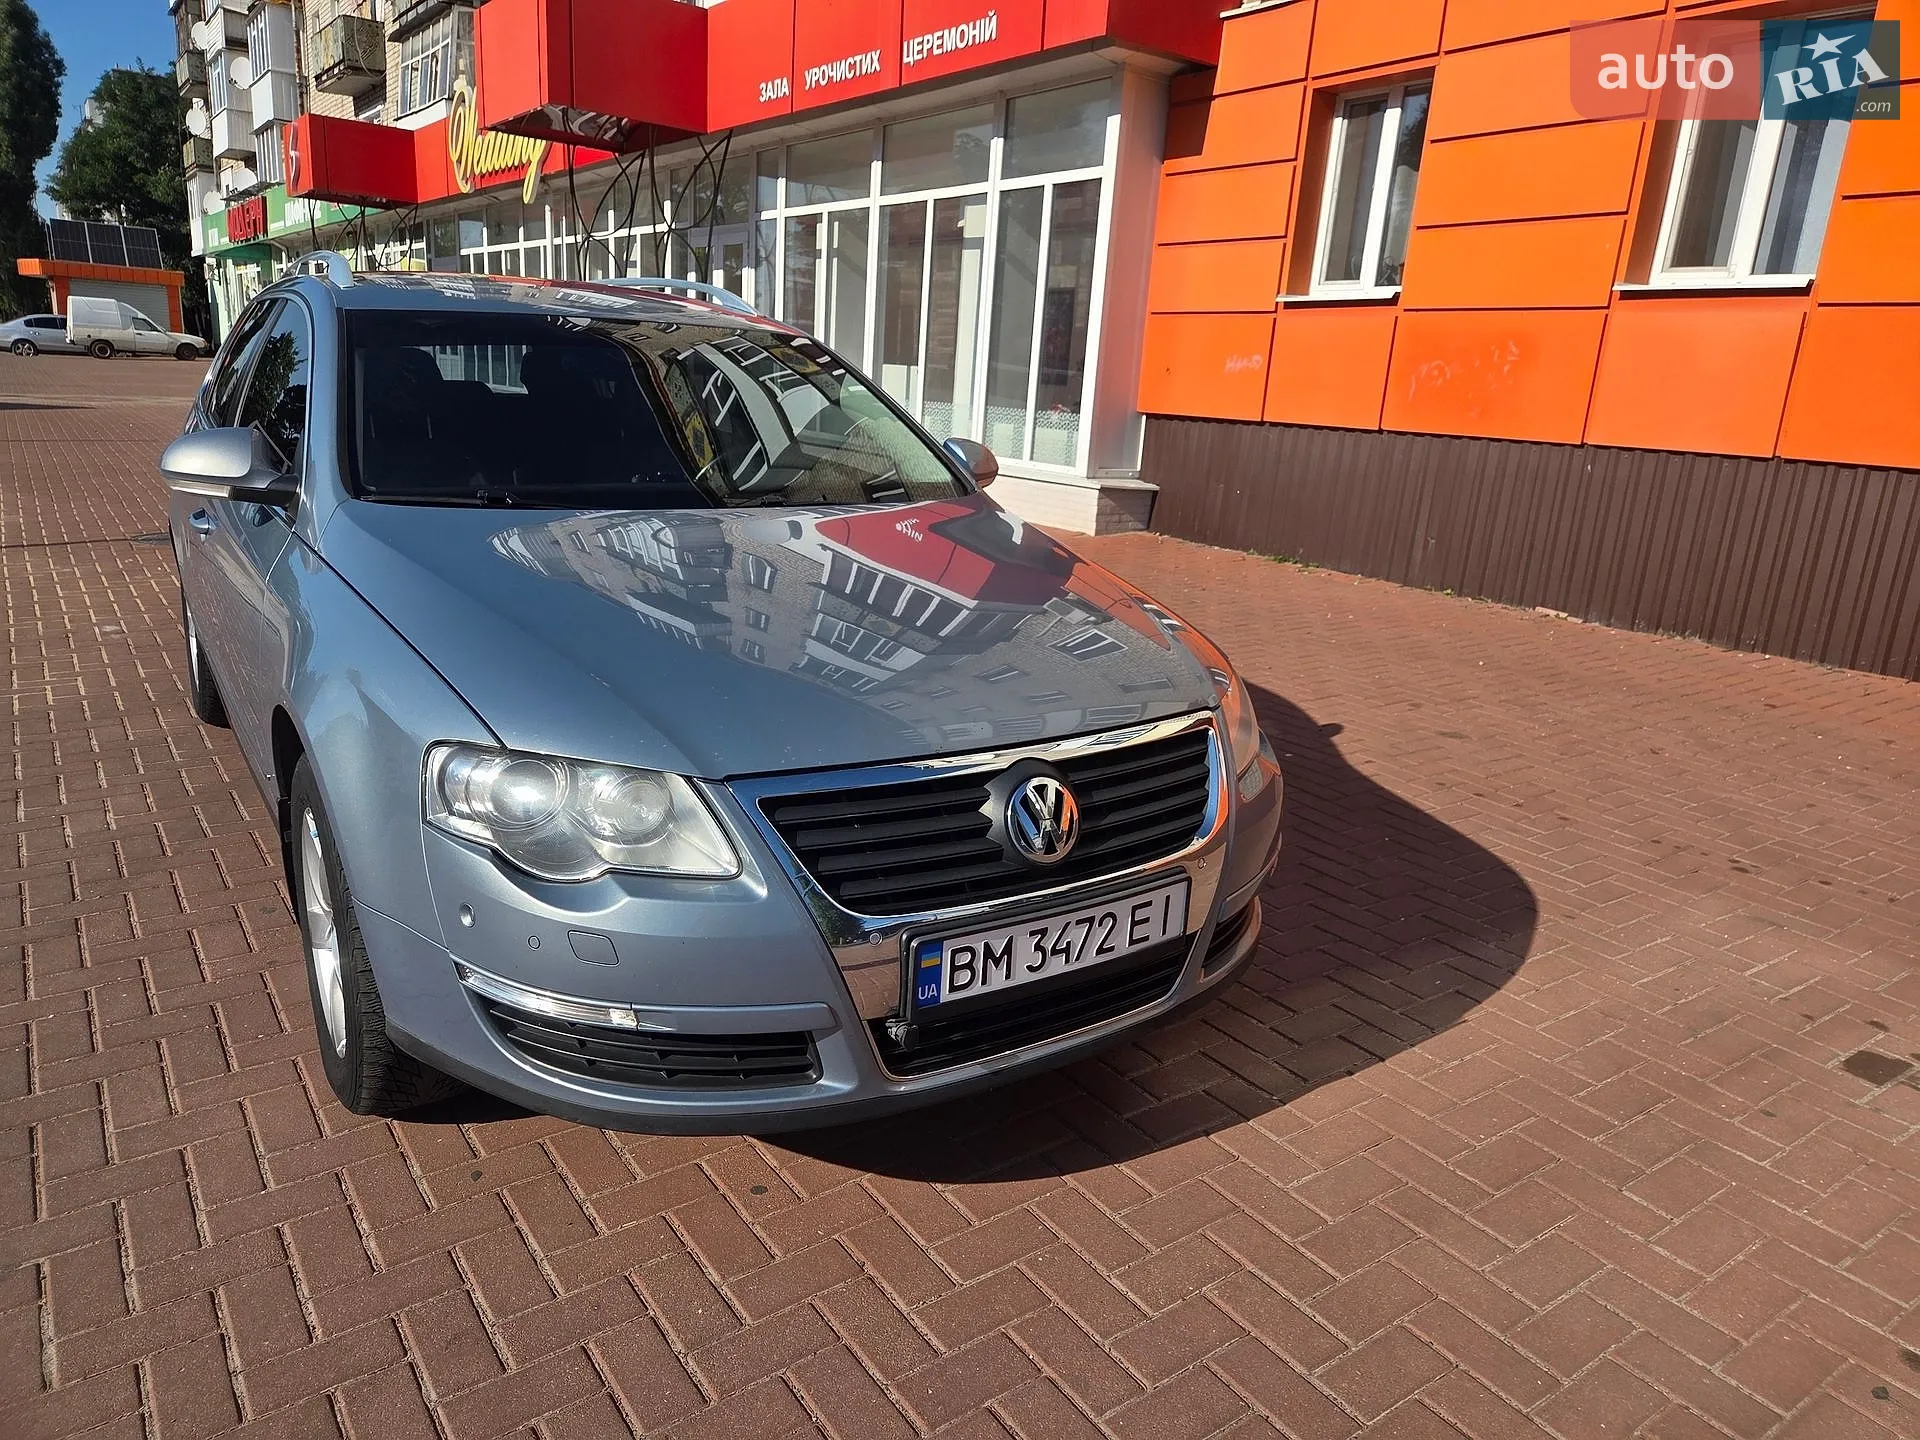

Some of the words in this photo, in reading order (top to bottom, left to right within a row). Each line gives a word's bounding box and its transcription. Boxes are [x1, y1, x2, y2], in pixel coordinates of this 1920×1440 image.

[759, 77, 790, 103] ЗАЛА
[804, 50, 881, 90] УРОЧИСТИХ
[903, 9, 998, 66] ЦЕРЕМОНІЙ
[918, 983, 938, 1000] UA
[948, 934, 1014, 995] BM
[1024, 911, 1118, 974] 3472
[1127, 894, 1171, 948] EI
